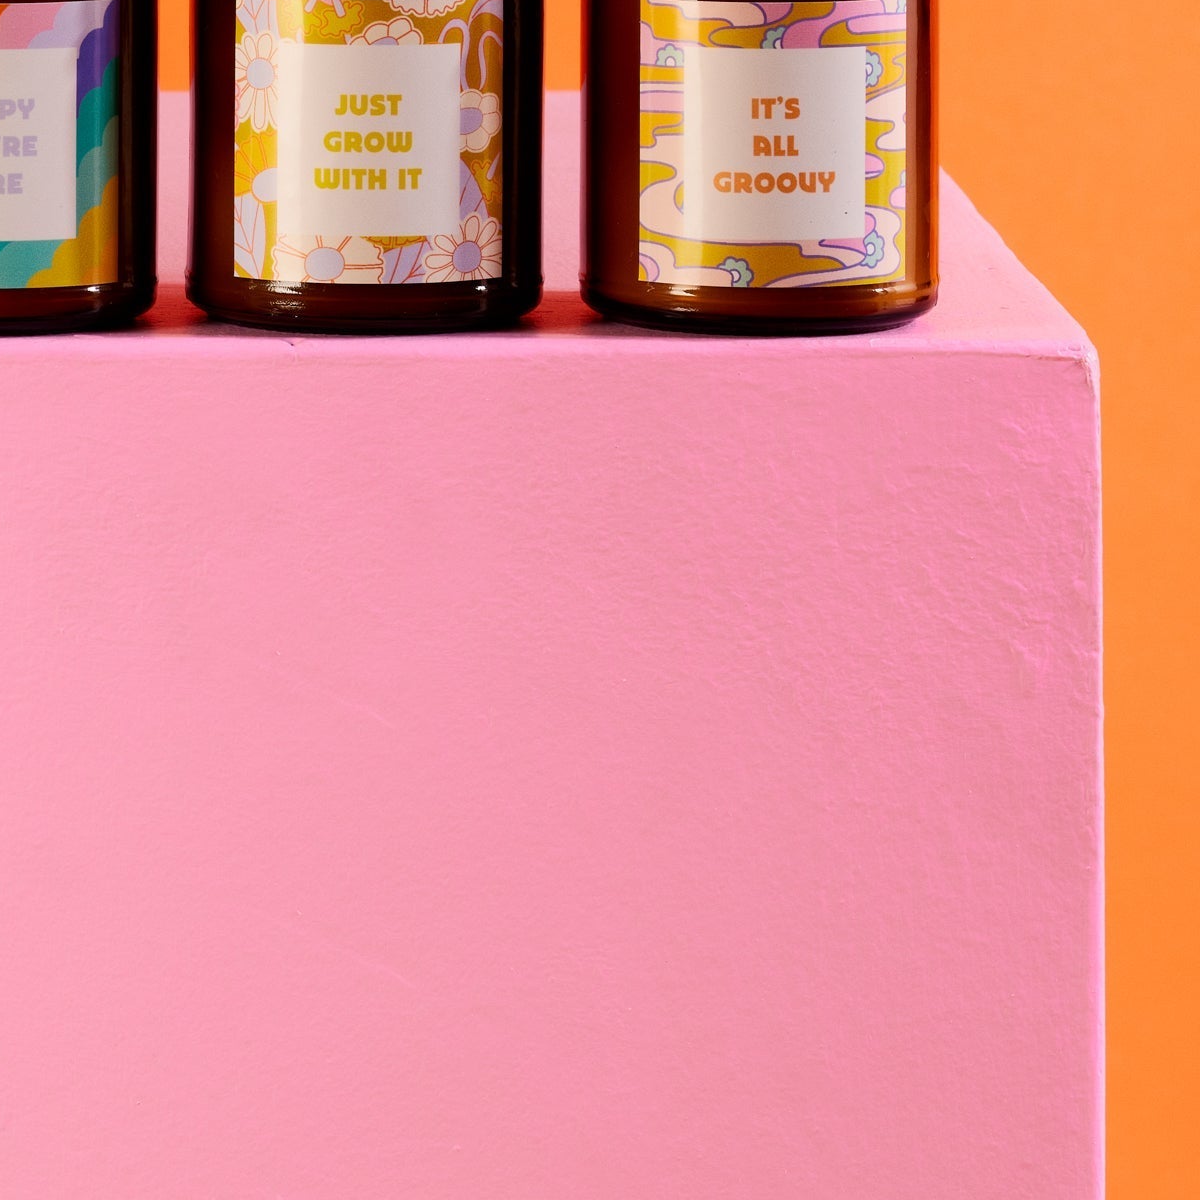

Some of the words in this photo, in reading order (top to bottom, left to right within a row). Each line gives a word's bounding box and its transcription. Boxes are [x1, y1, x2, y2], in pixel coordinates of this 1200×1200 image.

[334, 93, 403, 116] JUST
[751, 96, 801, 120] IT'S
[323, 131, 413, 153] GROW
[753, 135, 799, 157] ALL
[314, 168, 387, 190] WITH
[398, 168, 423, 190] IT
[713, 171, 836, 194] GROOVY
